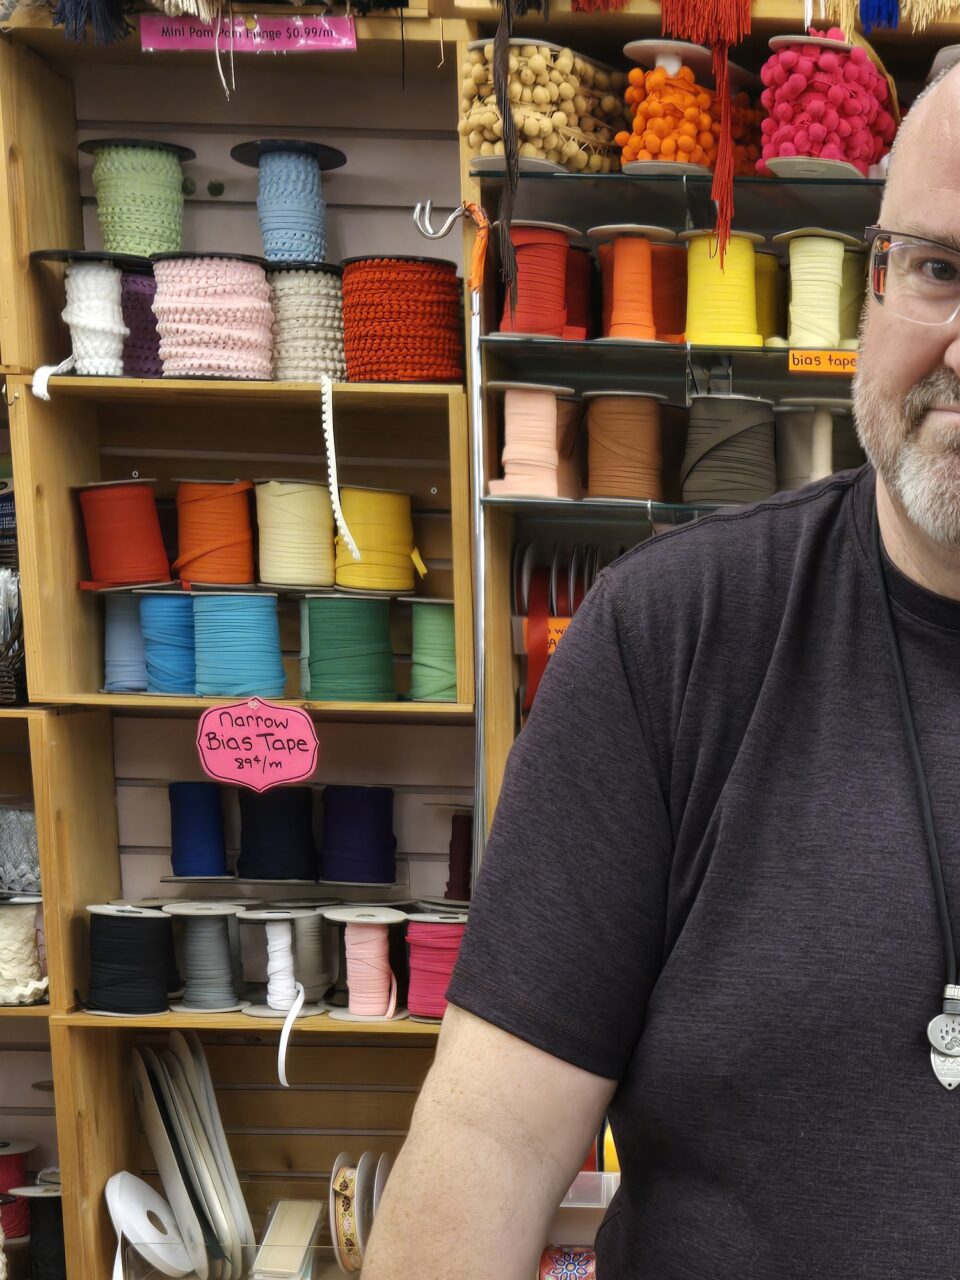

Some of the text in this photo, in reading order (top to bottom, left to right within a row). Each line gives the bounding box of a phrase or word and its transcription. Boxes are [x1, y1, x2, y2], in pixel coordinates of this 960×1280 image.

[161, 26, 185, 37] Mini
[189, 27, 214, 38] Pom
[286, 27, 334, 40] $0.99/m
[792, 353, 822, 366] bias
[205, 731, 310, 755] Bias Tape
